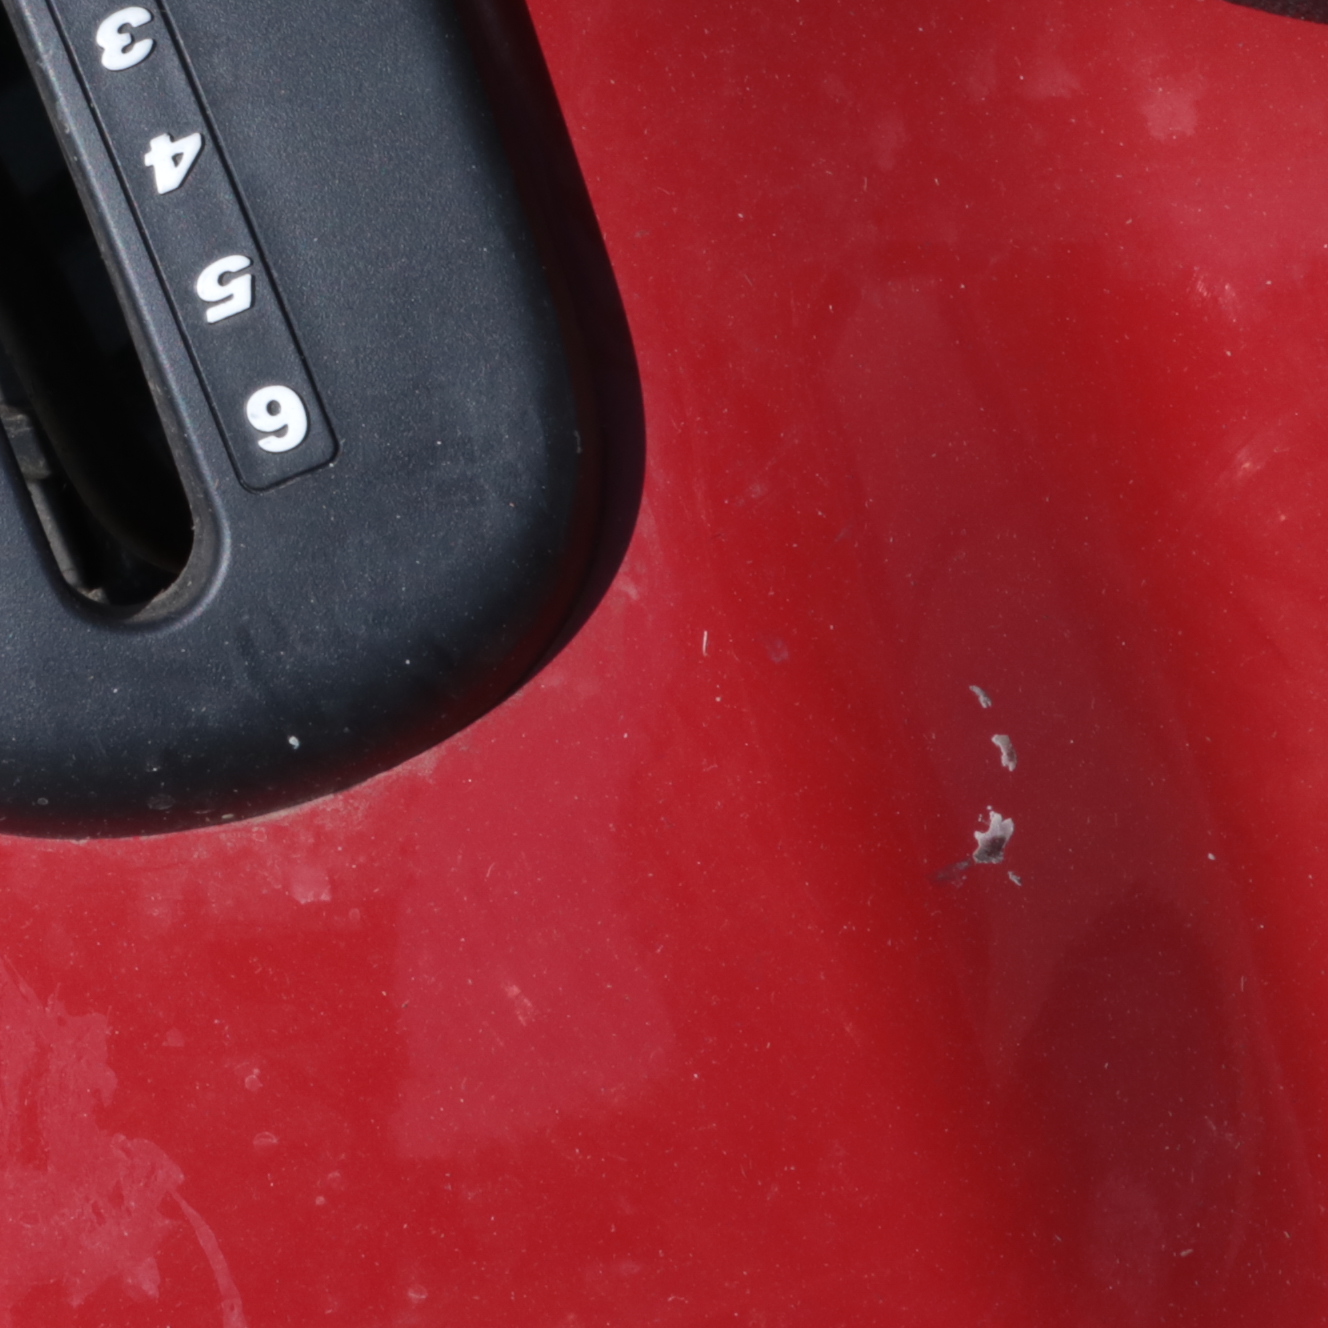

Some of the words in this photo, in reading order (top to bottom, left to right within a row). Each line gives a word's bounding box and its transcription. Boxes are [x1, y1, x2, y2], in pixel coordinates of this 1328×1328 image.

[94, 5, 154, 71] 3
[143, 131, 203, 195] 4
[194, 254, 253, 324] 5
[243, 384, 309, 454] 6
